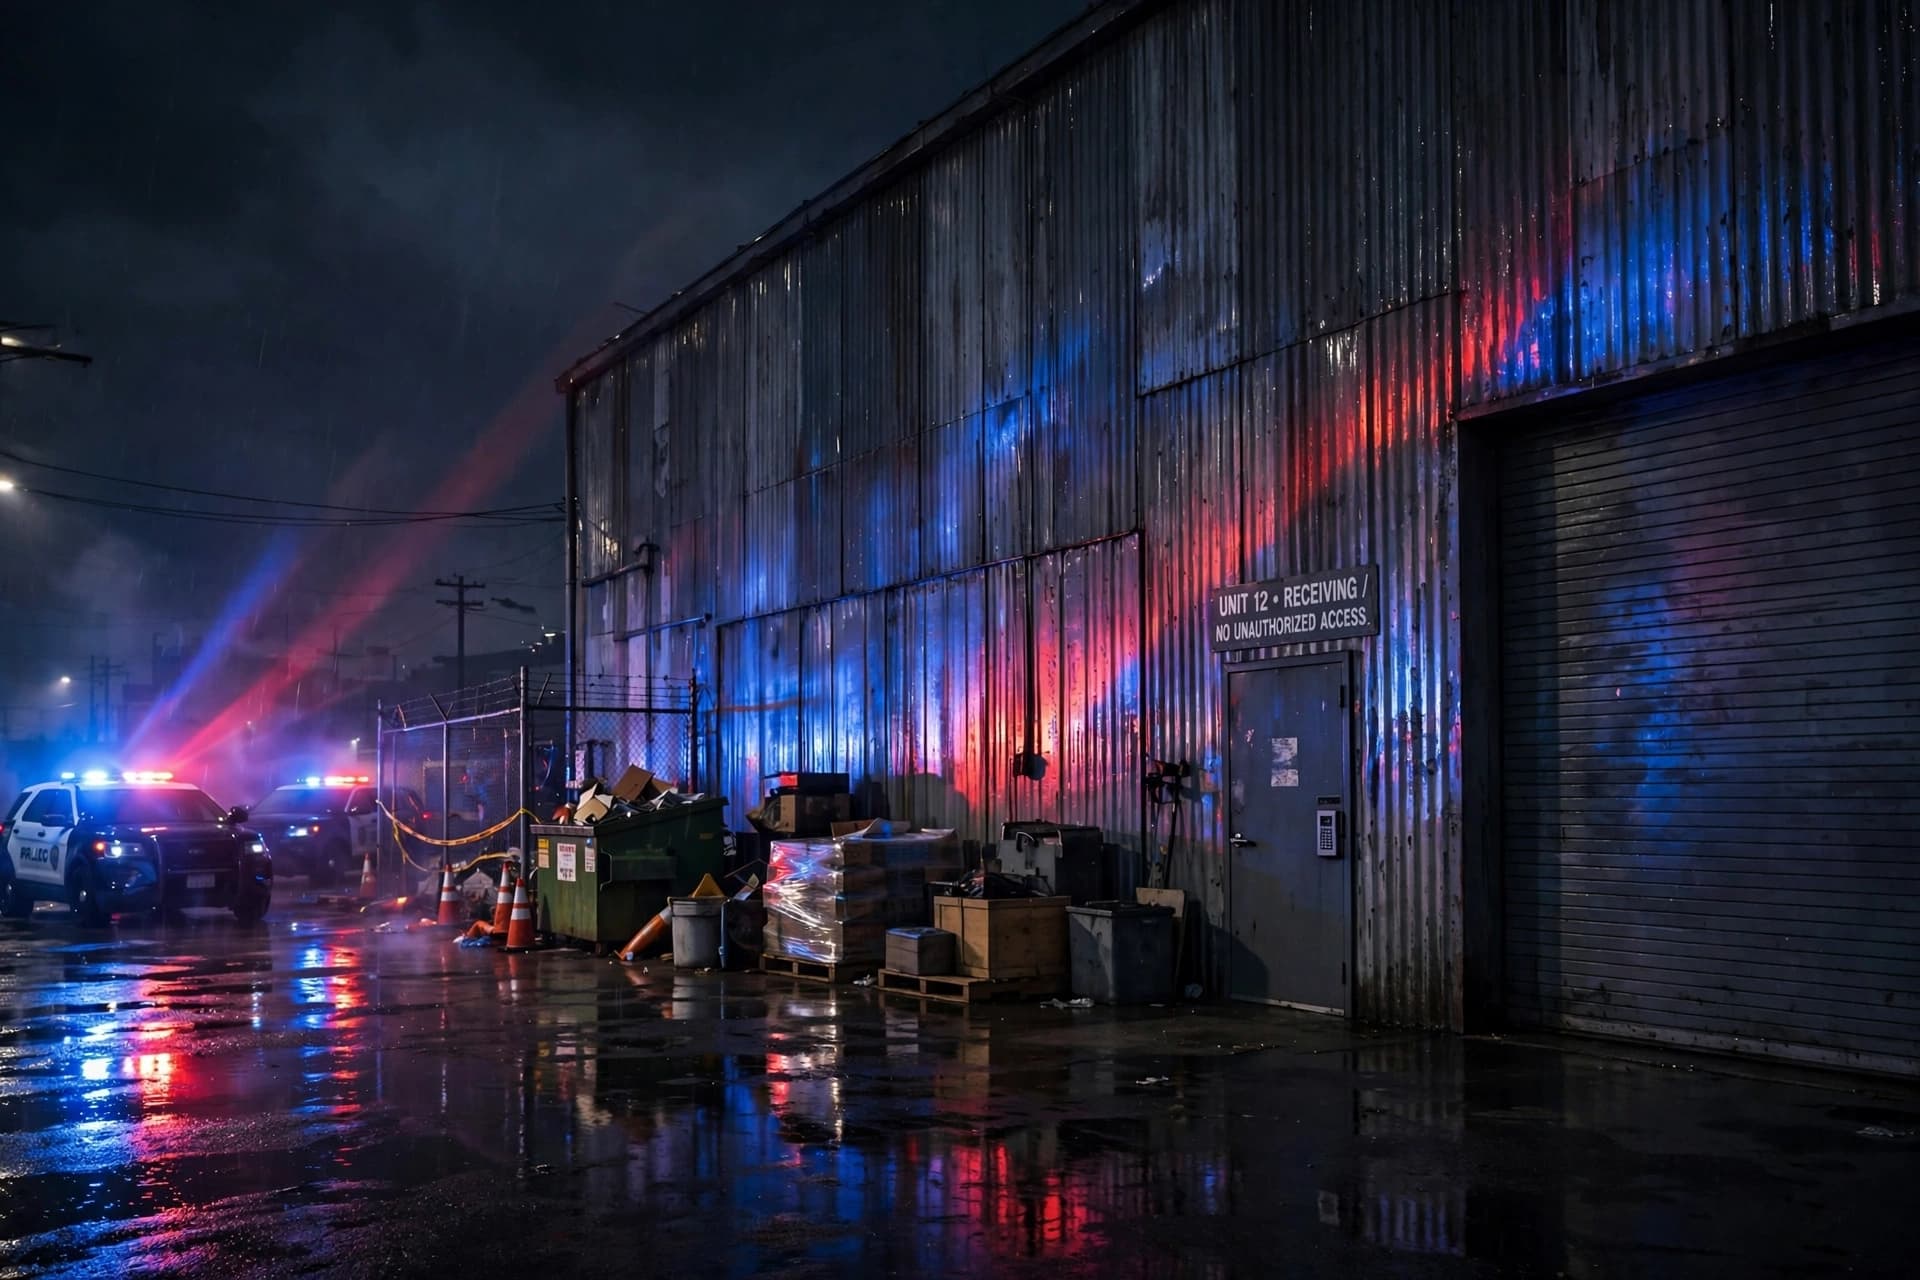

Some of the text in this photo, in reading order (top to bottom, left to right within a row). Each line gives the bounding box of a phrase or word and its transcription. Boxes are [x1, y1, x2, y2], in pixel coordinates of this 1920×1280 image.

[1220, 593, 1248, 617] UNIT
[1254, 591, 1268, 612] 12
[1284, 577, 1357, 608] RECEIVING
[1216, 624, 1230, 642] NO
[1234, 613, 1316, 640] UNAUTHORIZED
